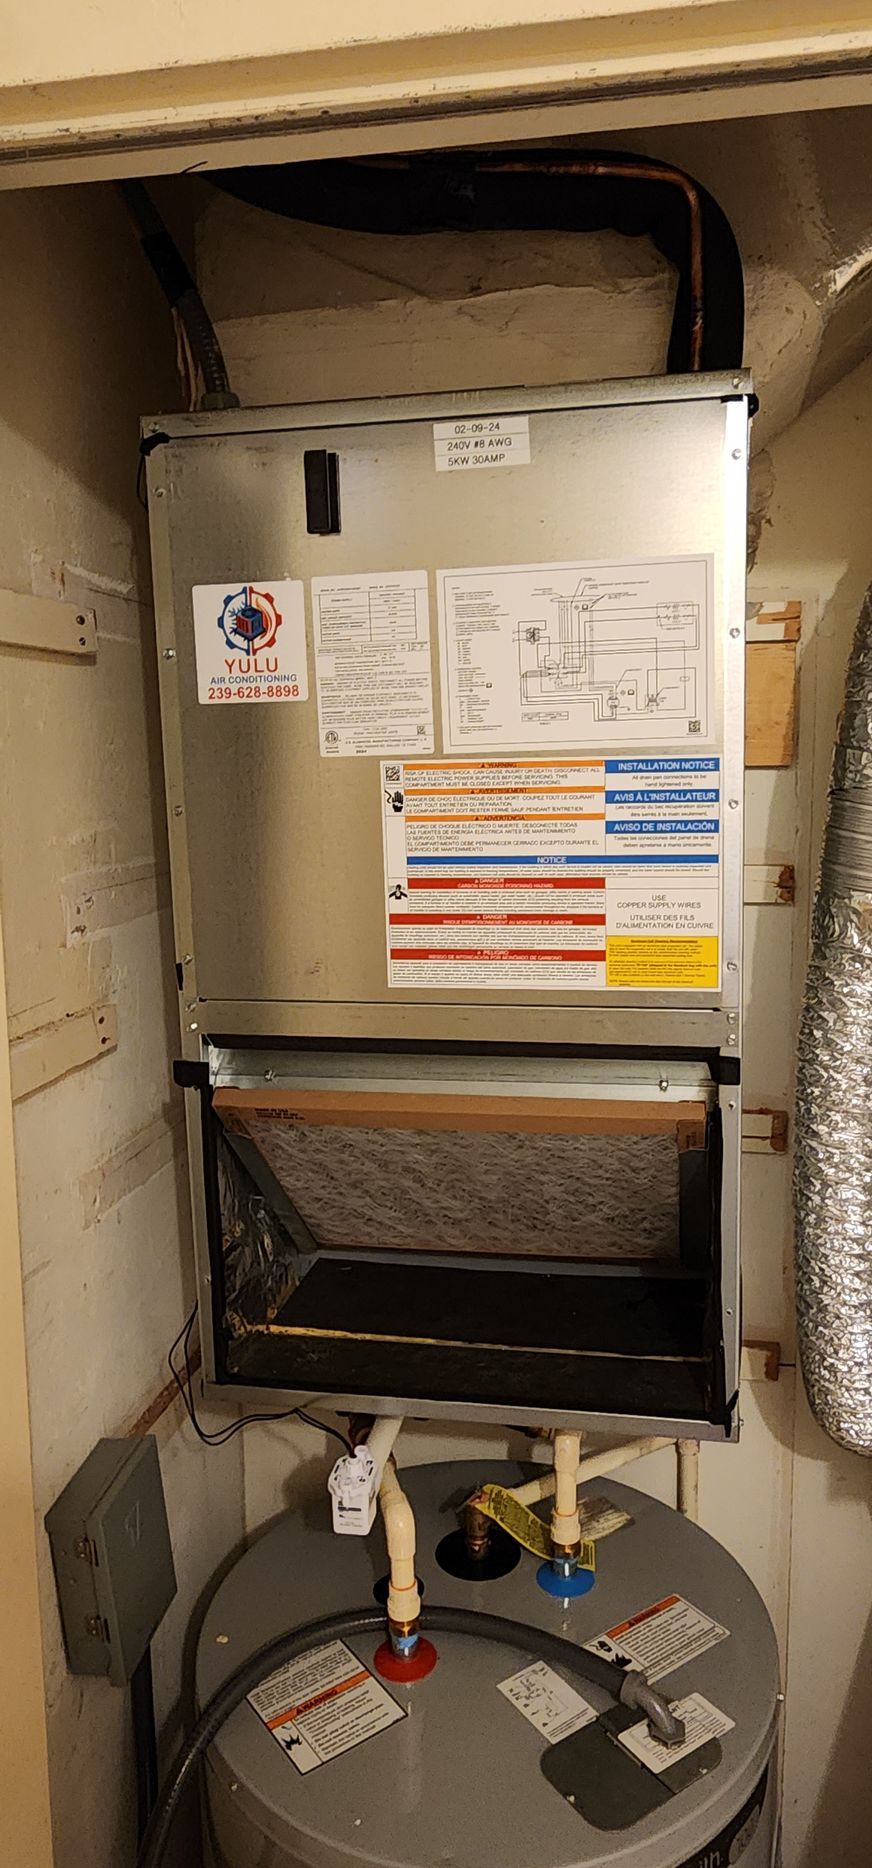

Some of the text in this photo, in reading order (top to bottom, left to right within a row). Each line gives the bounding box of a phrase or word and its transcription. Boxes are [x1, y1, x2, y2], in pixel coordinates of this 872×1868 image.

[454, 422, 500, 434] 02-09-24
[448, 437, 512, 451] 240V #8 AWG
[448, 454, 506, 466] 5KW 30AMP
[225, 658, 278, 674] YULU
[228, 674, 297, 684] CONDITIONING
[208, 685, 300, 700] 239-628-8898
[618, 761, 715, 770] INSTALLATION NOTICE
[614, 793, 634, 802] AVIS
[636, 792, 643, 801] À
[614, 821, 714, 831] AVISO DE INSTALACIÓN
[537, 856, 567, 864] NOTICE
